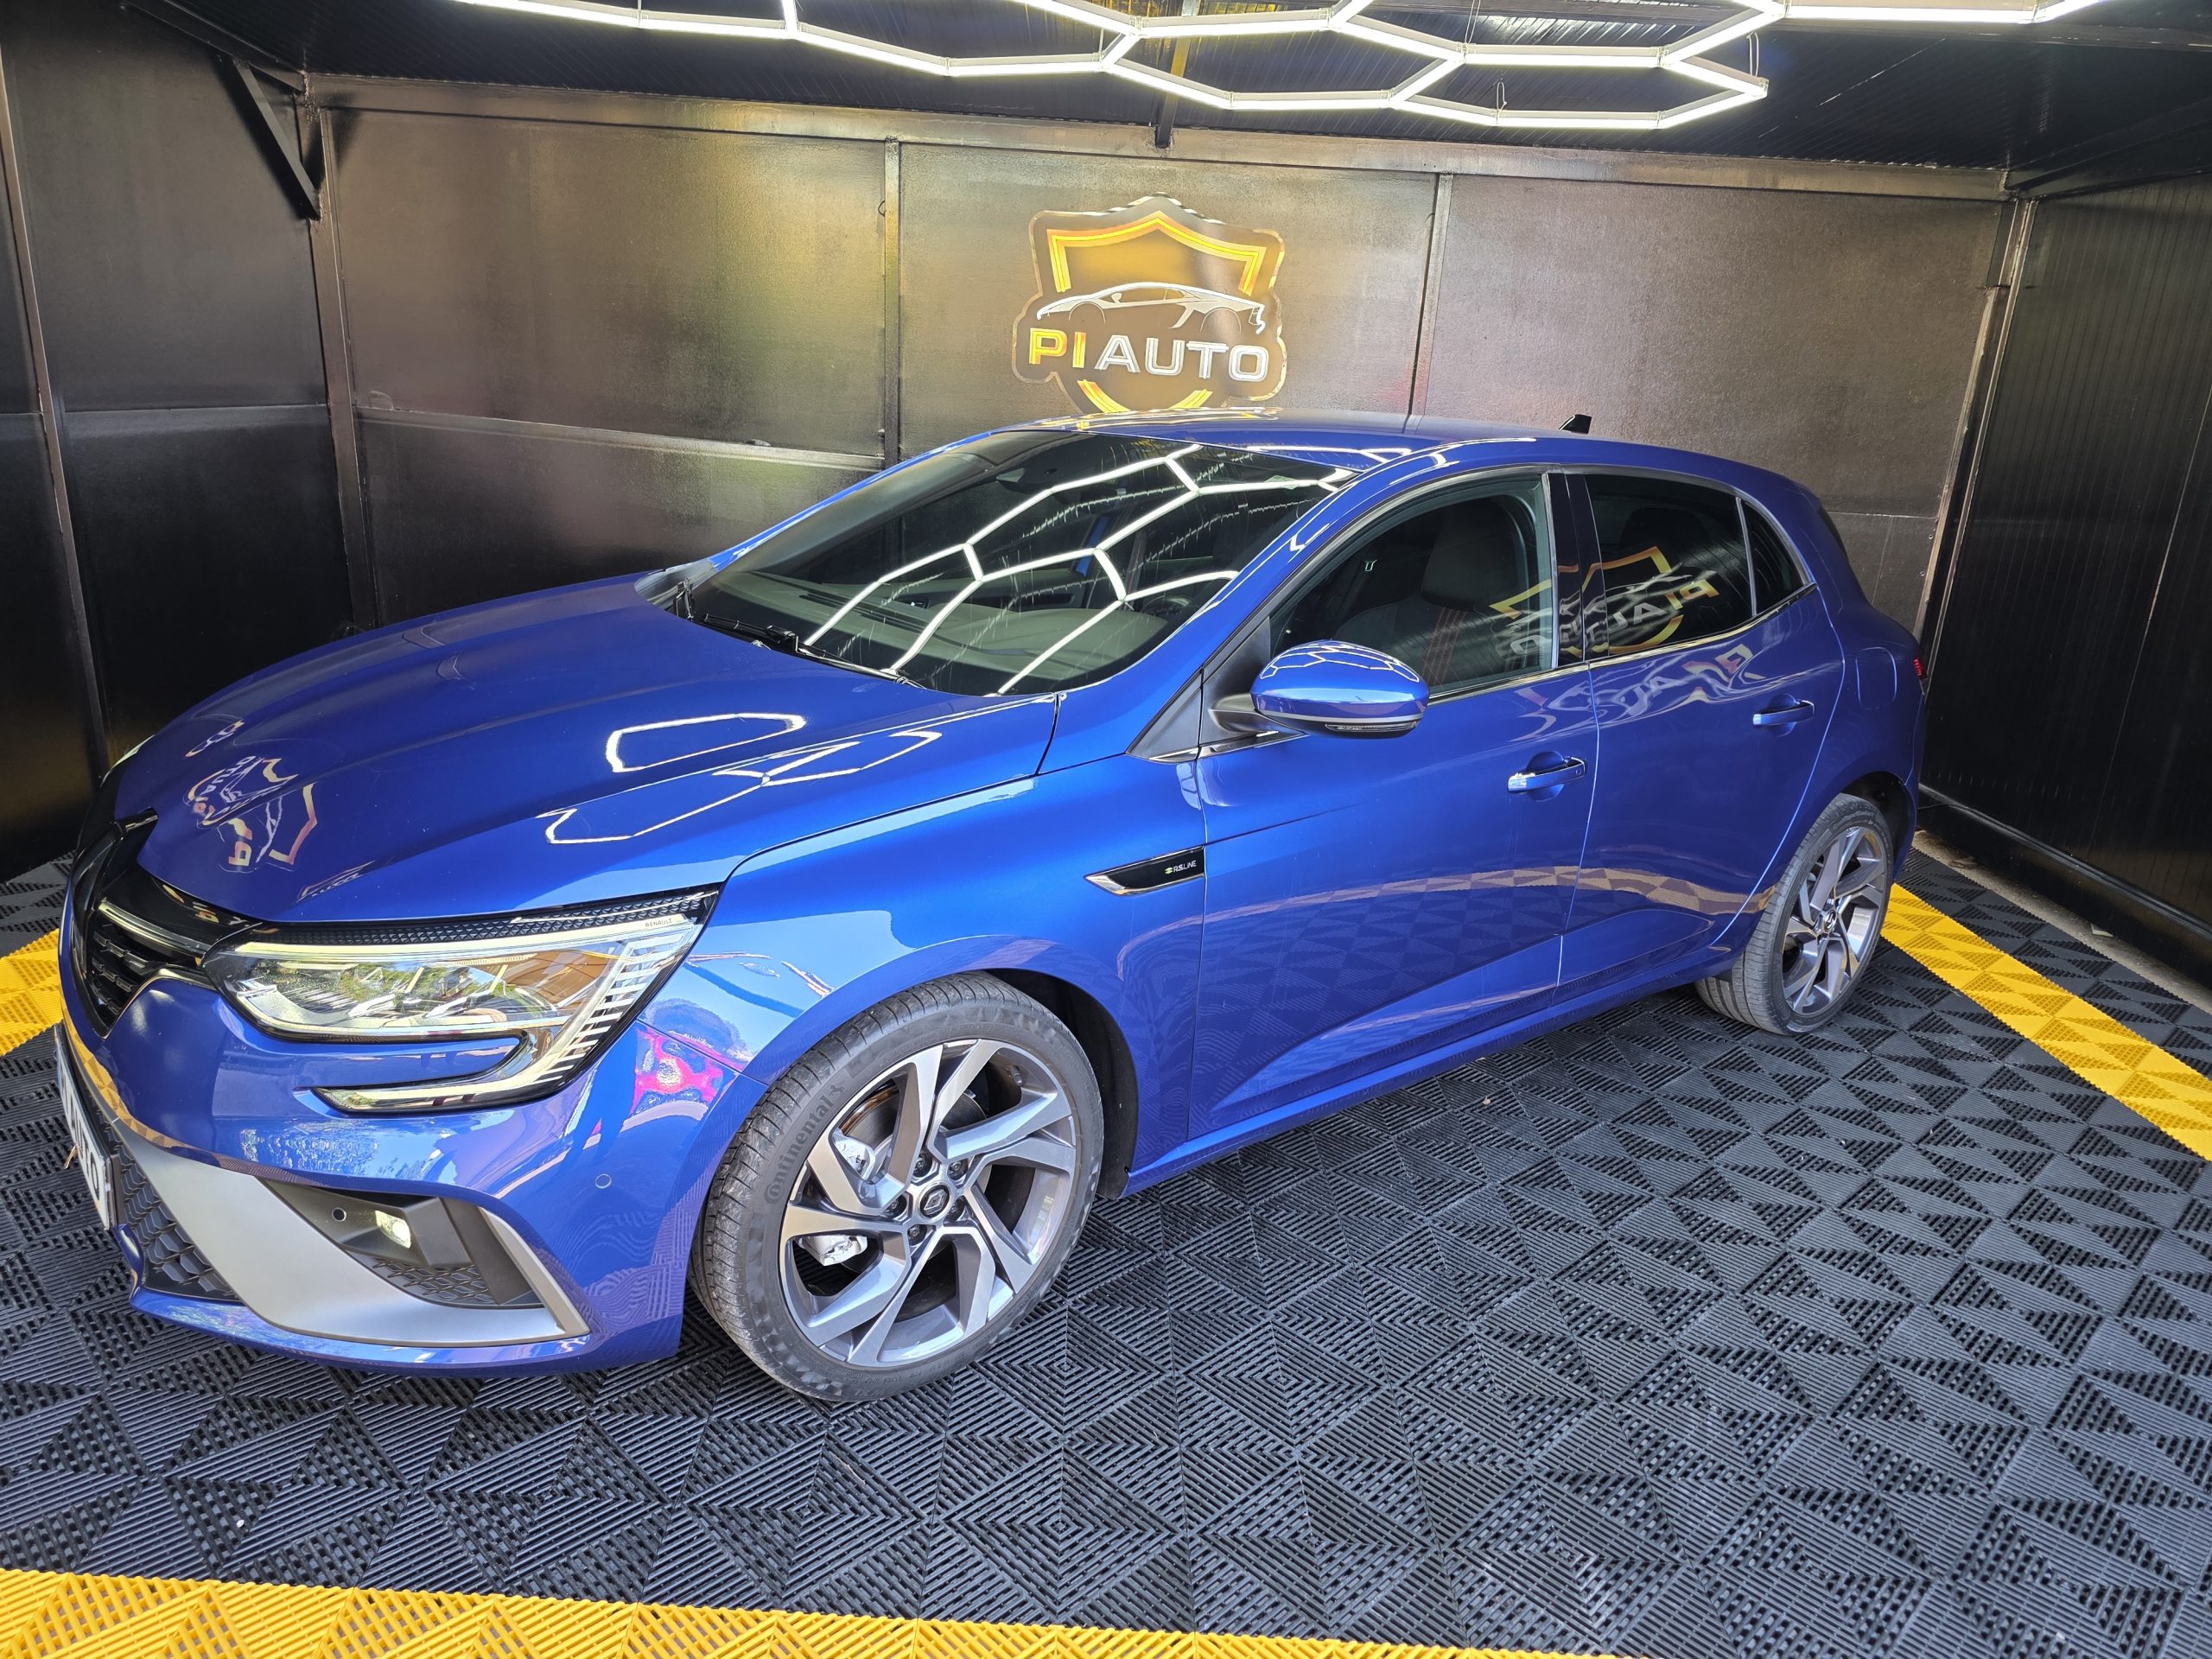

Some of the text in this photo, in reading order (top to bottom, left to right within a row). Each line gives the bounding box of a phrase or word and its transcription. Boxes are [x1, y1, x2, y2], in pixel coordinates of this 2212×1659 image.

[1029, 327, 1269, 382] PI AUTO
[645, 918, 672, 927] RENAULT
[764, 1095, 835, 1204] Continental
